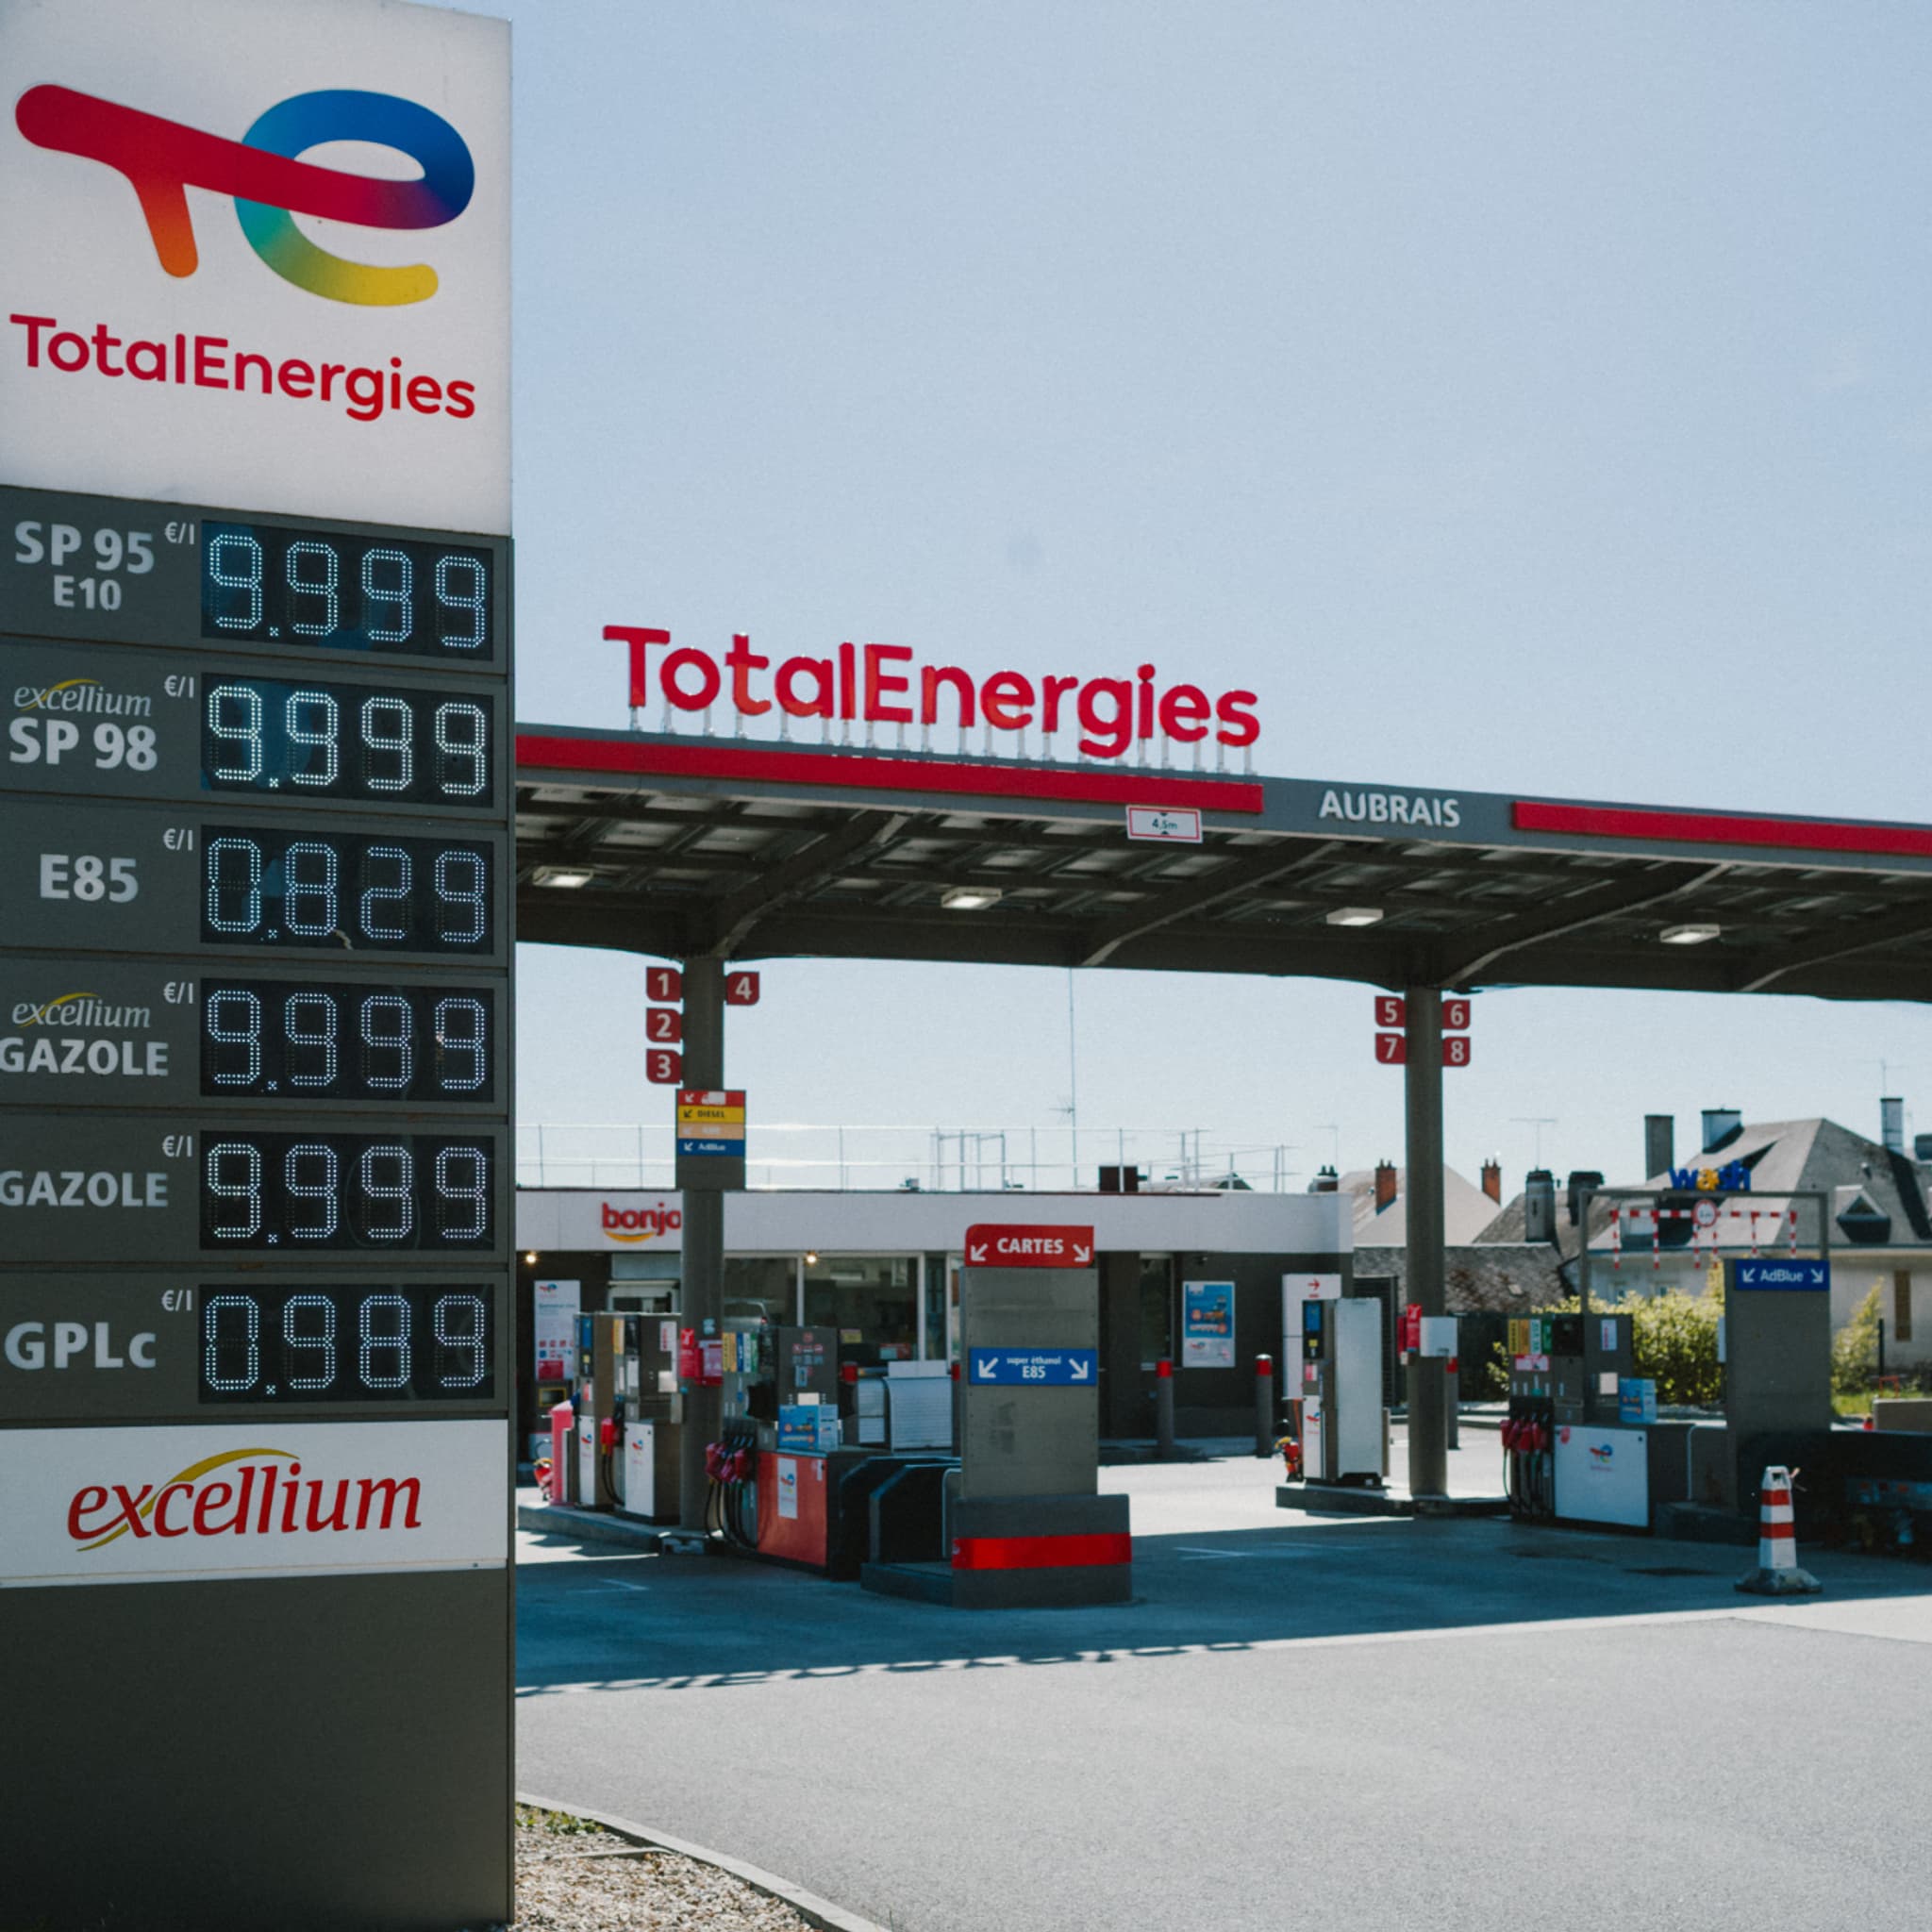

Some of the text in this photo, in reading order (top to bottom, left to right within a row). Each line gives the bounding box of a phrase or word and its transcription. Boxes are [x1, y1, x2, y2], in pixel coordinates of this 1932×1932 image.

[9, 314, 475, 421] TotalEnergies
[14, 521, 155, 574] SP 95
[54, 575, 122, 611] E10
[208, 534, 486, 648] 9.999
[14, 681, 152, 717] excellium
[603, 625, 1260, 758] TotalEnergies
[8, 718, 158, 771] SP 98
[208, 685, 486, 795] 9.999
[1320, 790, 1460, 828] AUBRAIS
[40, 854, 139, 903] E85
[208, 837, 486, 942] 0.829
[658, 973, 669, 996] 1
[736, 976, 752, 1001] 4
[12, 997, 151, 1028] excellium
[657, 1013, 672, 1038] 2
[1385, 1001, 1398, 1024] 5
[1450, 1004, 1464, 1026] 6
[0, 1037, 169, 1077] GAZOLE
[208, 990, 486, 1090] 9.999
[1384, 1037, 1398, 1060] 7
[1450, 1041, 1465, 1063] 8
[657, 1055, 671, 1078] 3
[0, 1170, 168, 1208] GAZOLE
[208, 1143, 486, 1243] 9.999
[997, 1237, 1064, 1255] CARTES
[1760, 1269, 1804, 1282] AdBlue
[5, 1322, 156, 1370] GPLc
[206, 1294, 486, 1395] 0.989
[1023, 1365, 1046, 1378] E85
[68, 1459, 421, 1541] excellium
